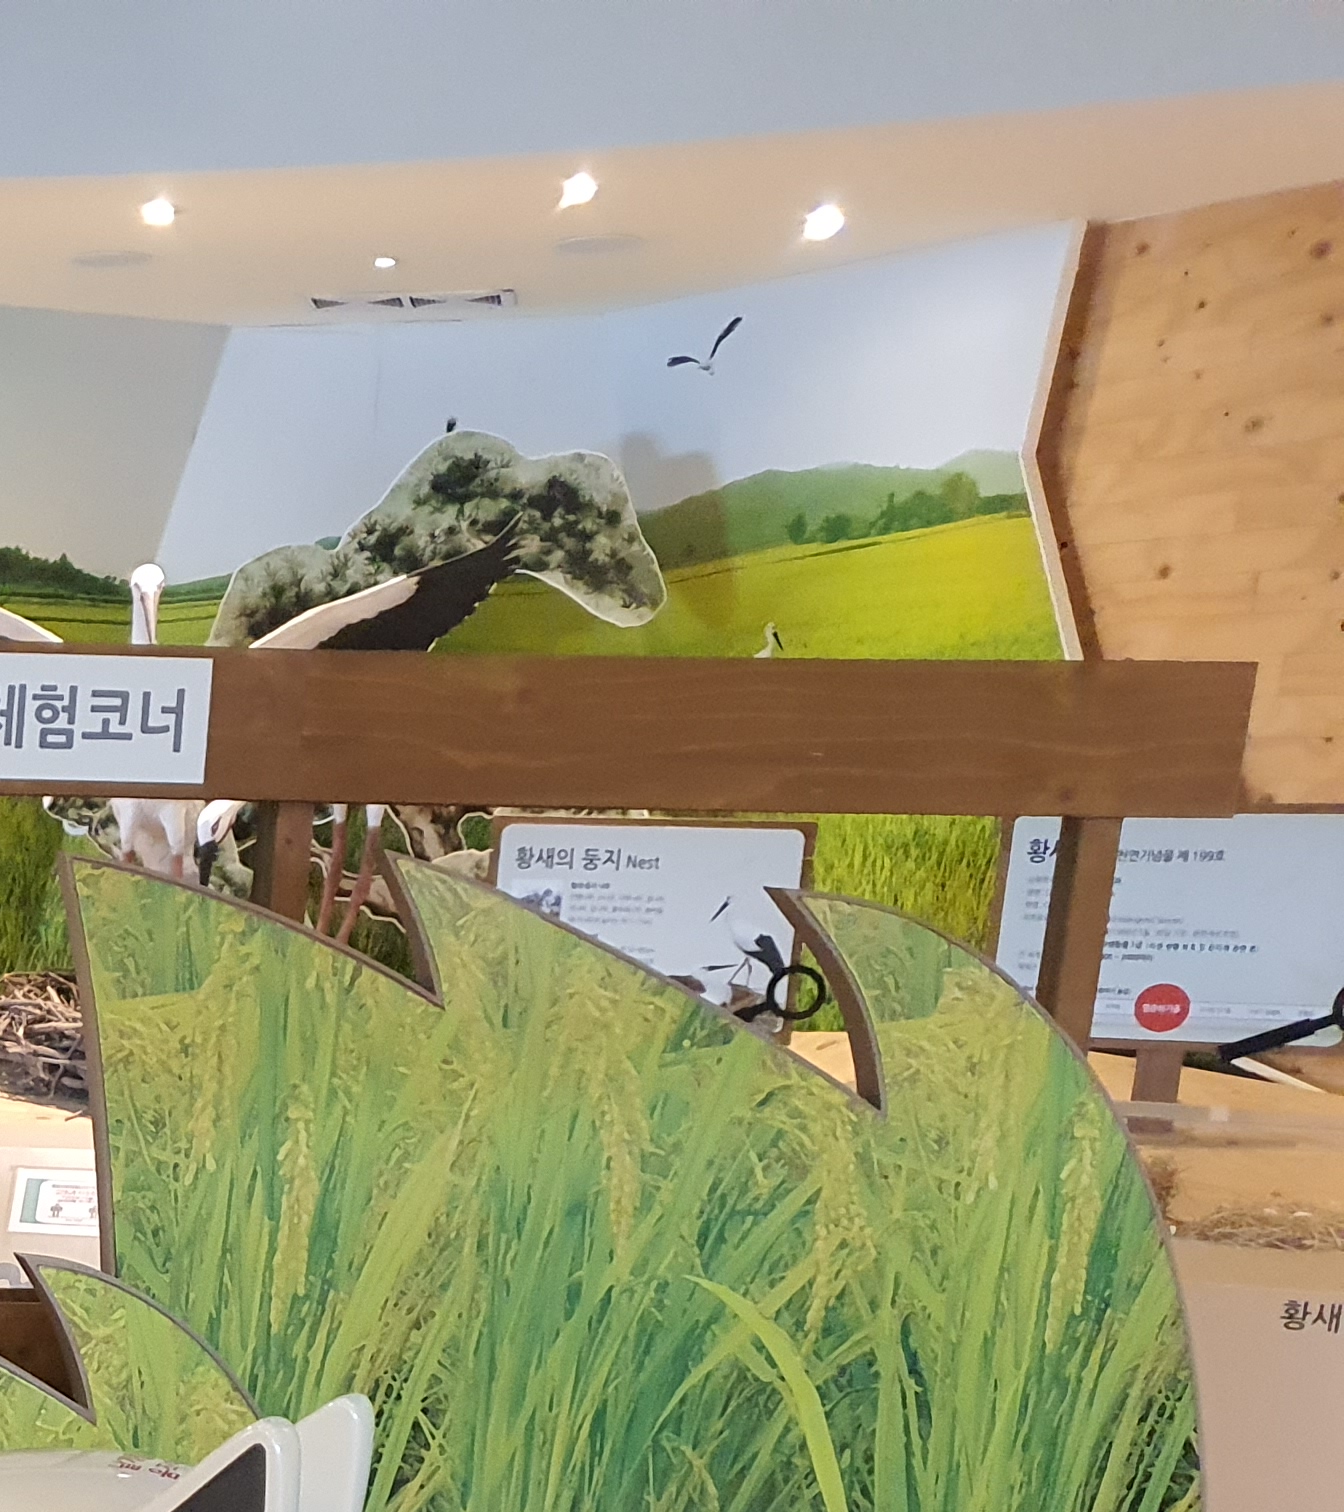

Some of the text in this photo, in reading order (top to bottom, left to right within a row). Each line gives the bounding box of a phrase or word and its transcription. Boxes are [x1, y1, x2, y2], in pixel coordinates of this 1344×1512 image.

[515, 846, 661, 871] 황새의 둥지 Nest
[1279, 1299, 1343, 1334] 황새
